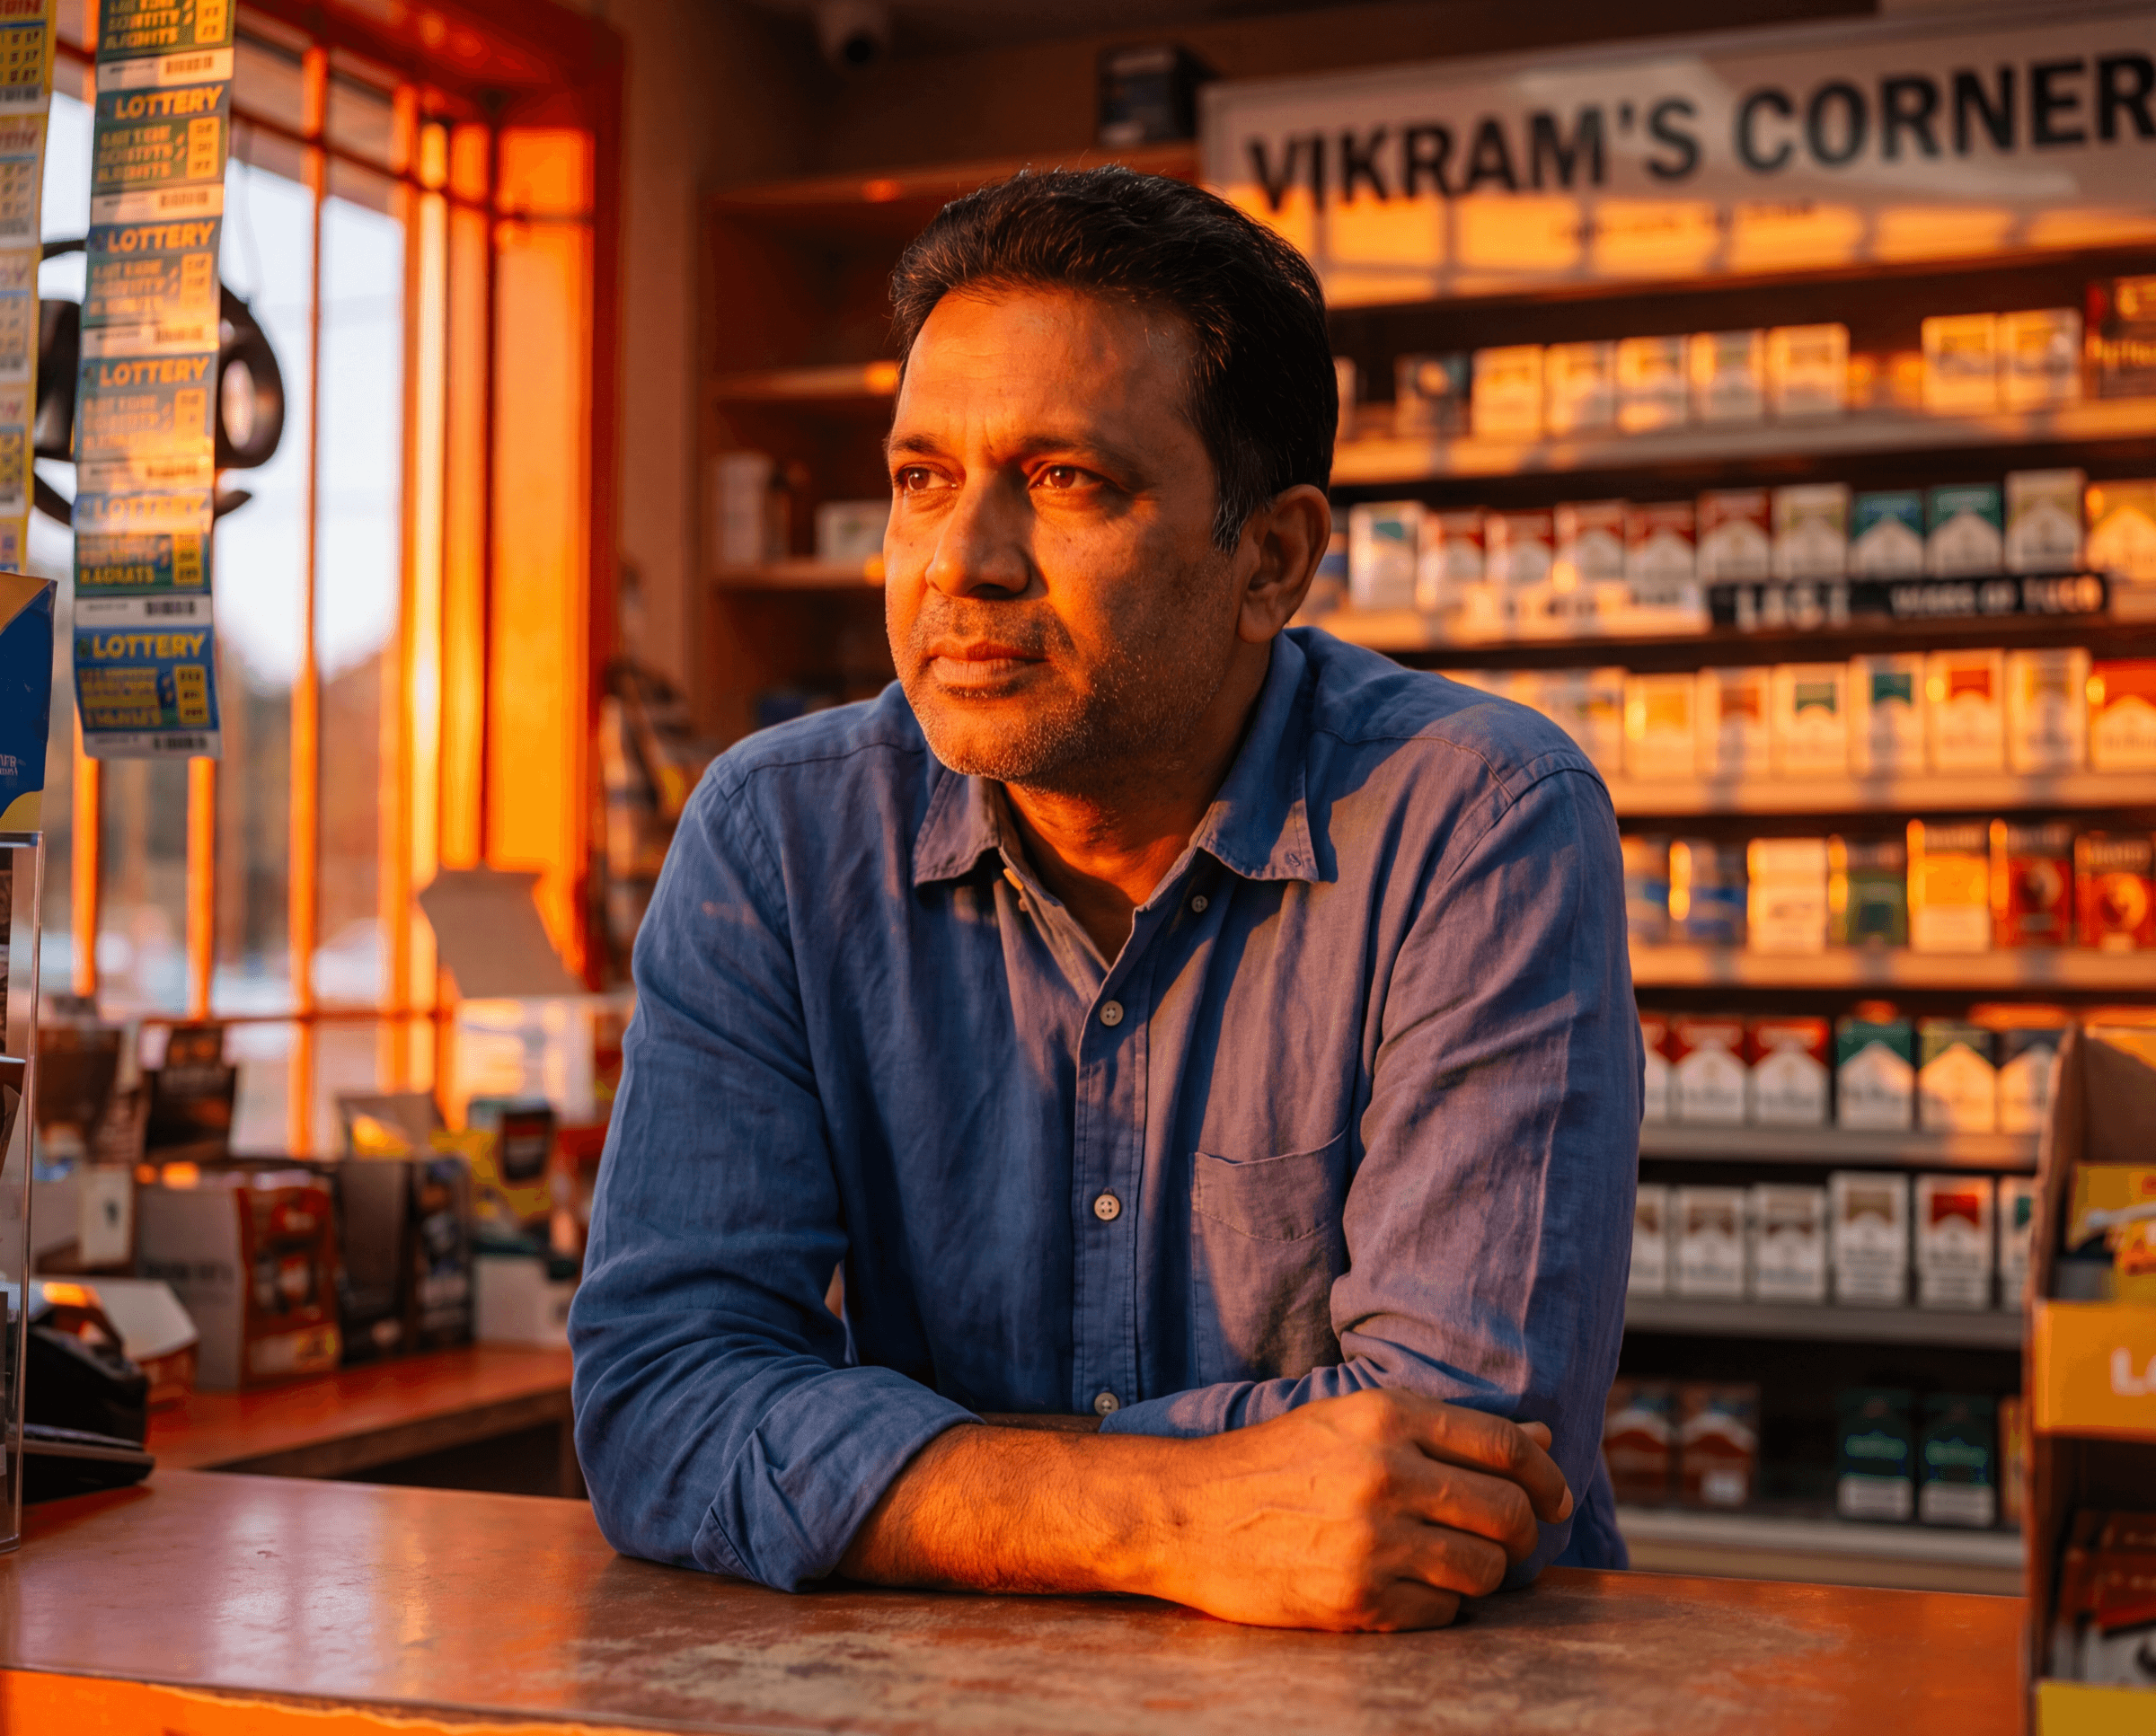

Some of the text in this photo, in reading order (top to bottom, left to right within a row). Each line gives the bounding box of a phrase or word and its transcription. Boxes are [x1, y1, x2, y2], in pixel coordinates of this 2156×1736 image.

[116, 87, 224, 119] LOTTERY
[1248, 54, 2156, 212] VIKRAM'S CORNER
[109, 222, 216, 253] LOTTERY
[100, 357, 208, 387] LOTTERY
[93, 634, 206, 659] LOTTERY
